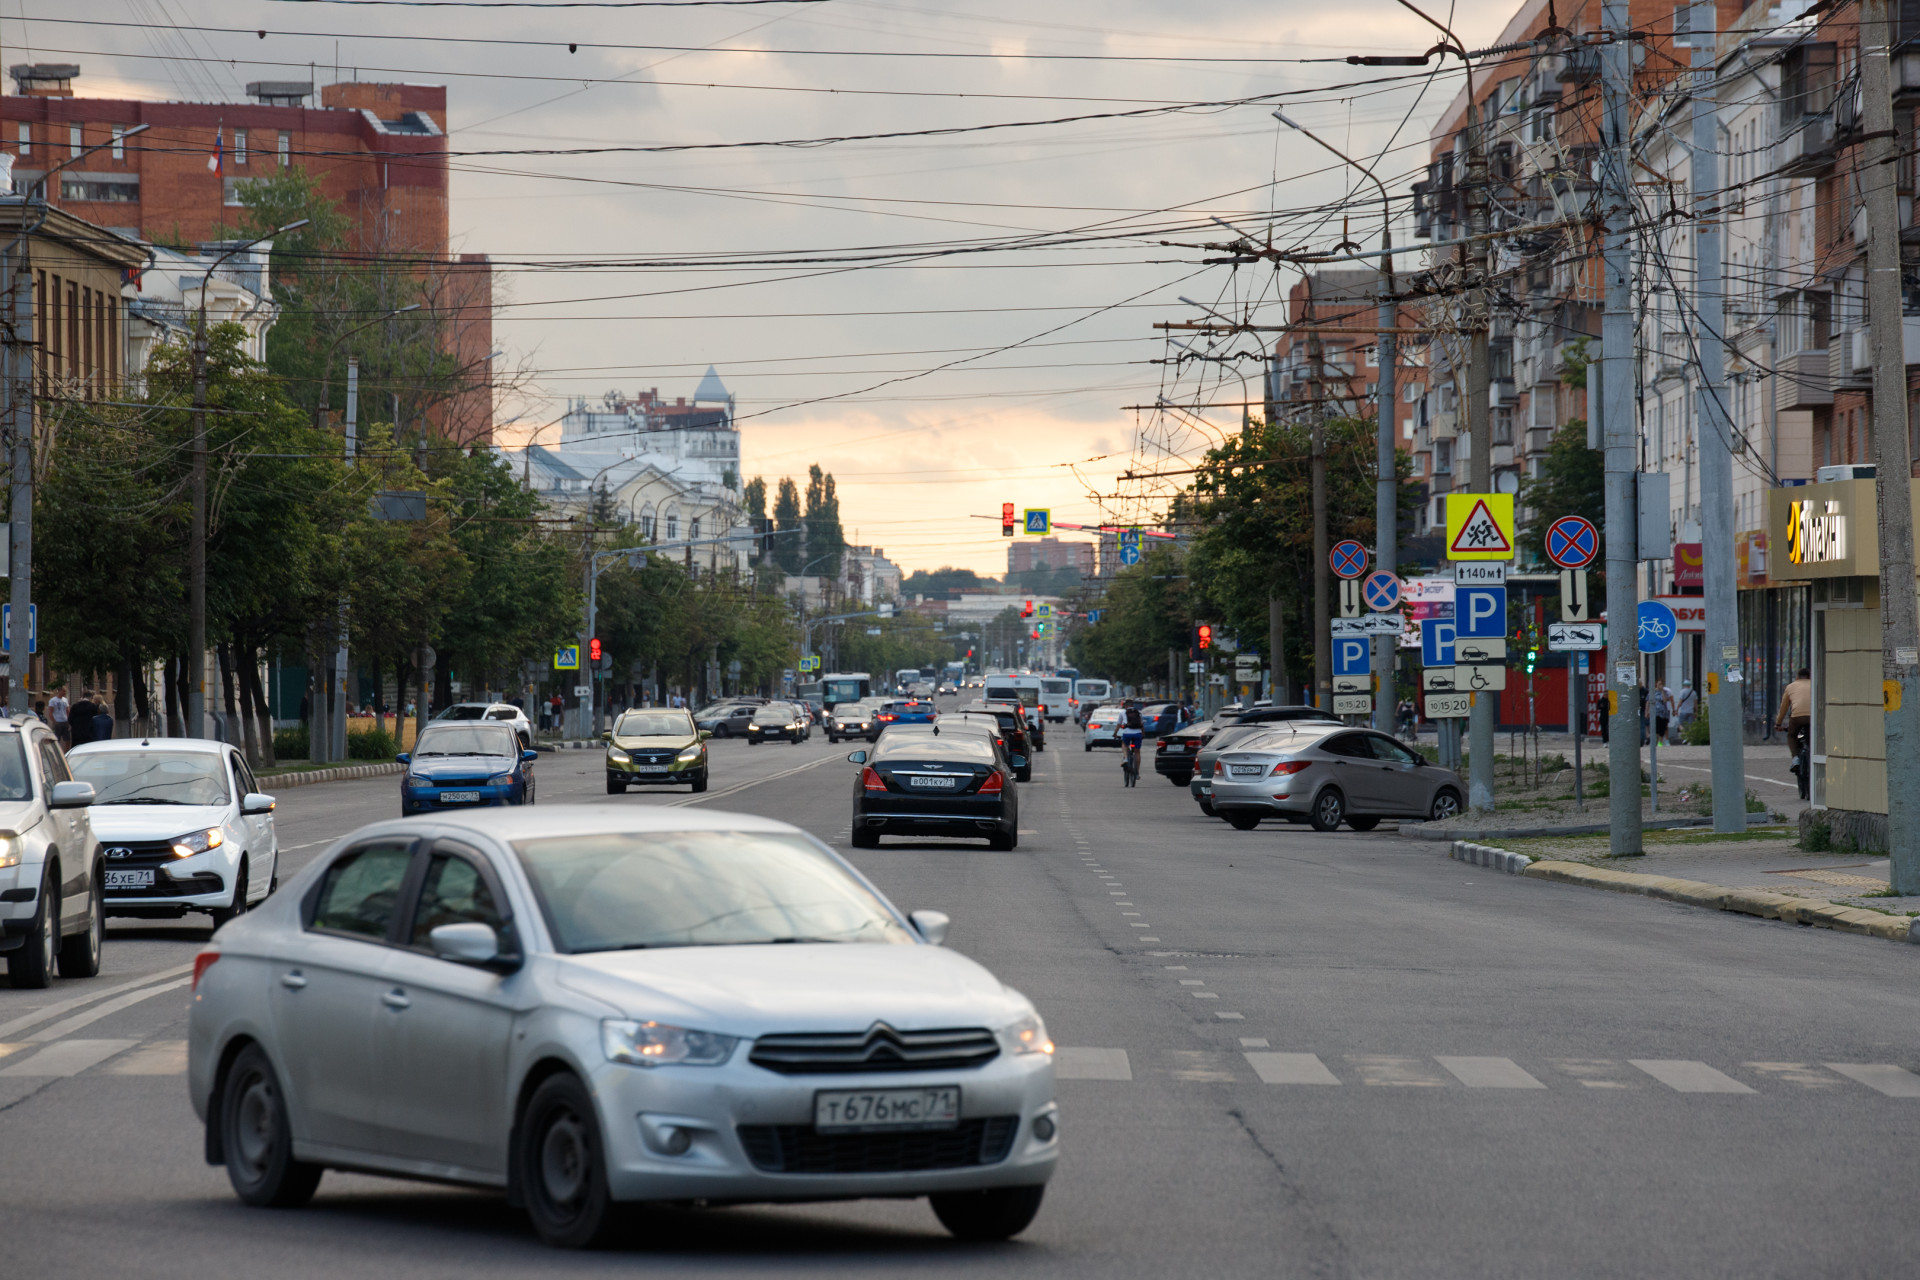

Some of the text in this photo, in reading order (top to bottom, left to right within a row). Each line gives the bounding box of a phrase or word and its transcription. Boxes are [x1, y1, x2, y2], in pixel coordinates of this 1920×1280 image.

[1467, 567, 1486, 579] 140
[1355, 700, 1367, 708] 20
[1441, 701, 1450, 710] 15
[1453, 701, 1467, 710] 20
[1588, 673, 1596, 731] ОПТИКА
